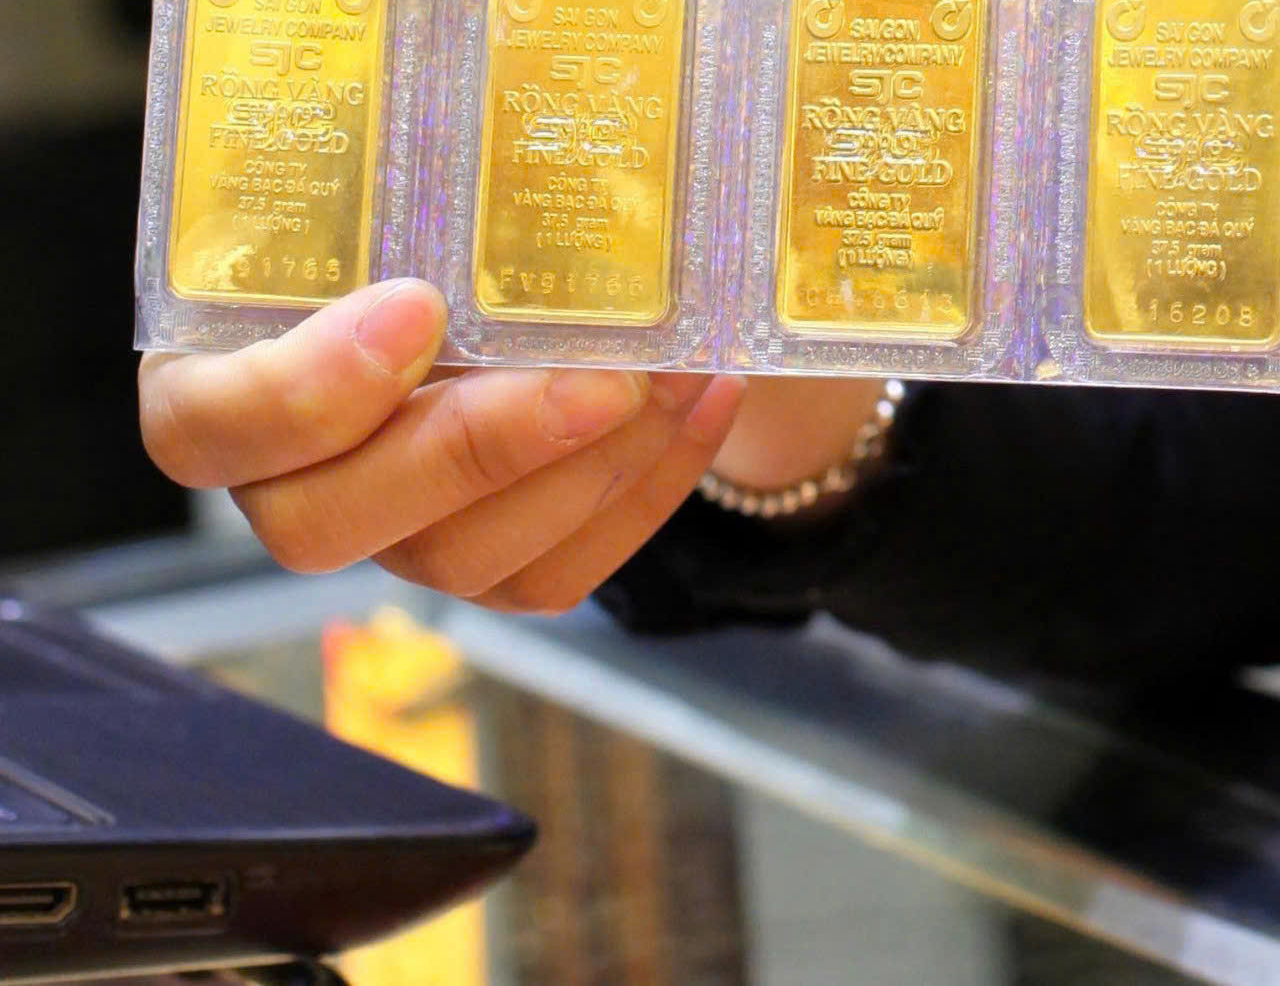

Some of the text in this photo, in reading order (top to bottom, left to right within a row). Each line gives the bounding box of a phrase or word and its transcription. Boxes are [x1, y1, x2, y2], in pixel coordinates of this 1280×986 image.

[286, 18, 367, 41] COMPANY
[552, 6, 620, 28] SAI GON
[885, 19, 920, 41] GON
[585, 31, 663, 53] COMPANY
[1157, 21, 1225, 43] SAI GON
[250, 39, 323, 76] SJC
[884, 43, 966, 67] COMPANY
[1189, 48, 1273, 70] COMPANY
[550, 54, 622, 90] SJC
[287, 77, 364, 106] VÀNG
[849, 69, 924, 104] SJC
[1153, 73, 1229, 109] SJC
[587, 92, 664, 119] VÀNG
[887, 102, 967, 134] VÀNG
[1192, 107, 1274, 138] VÀNG
